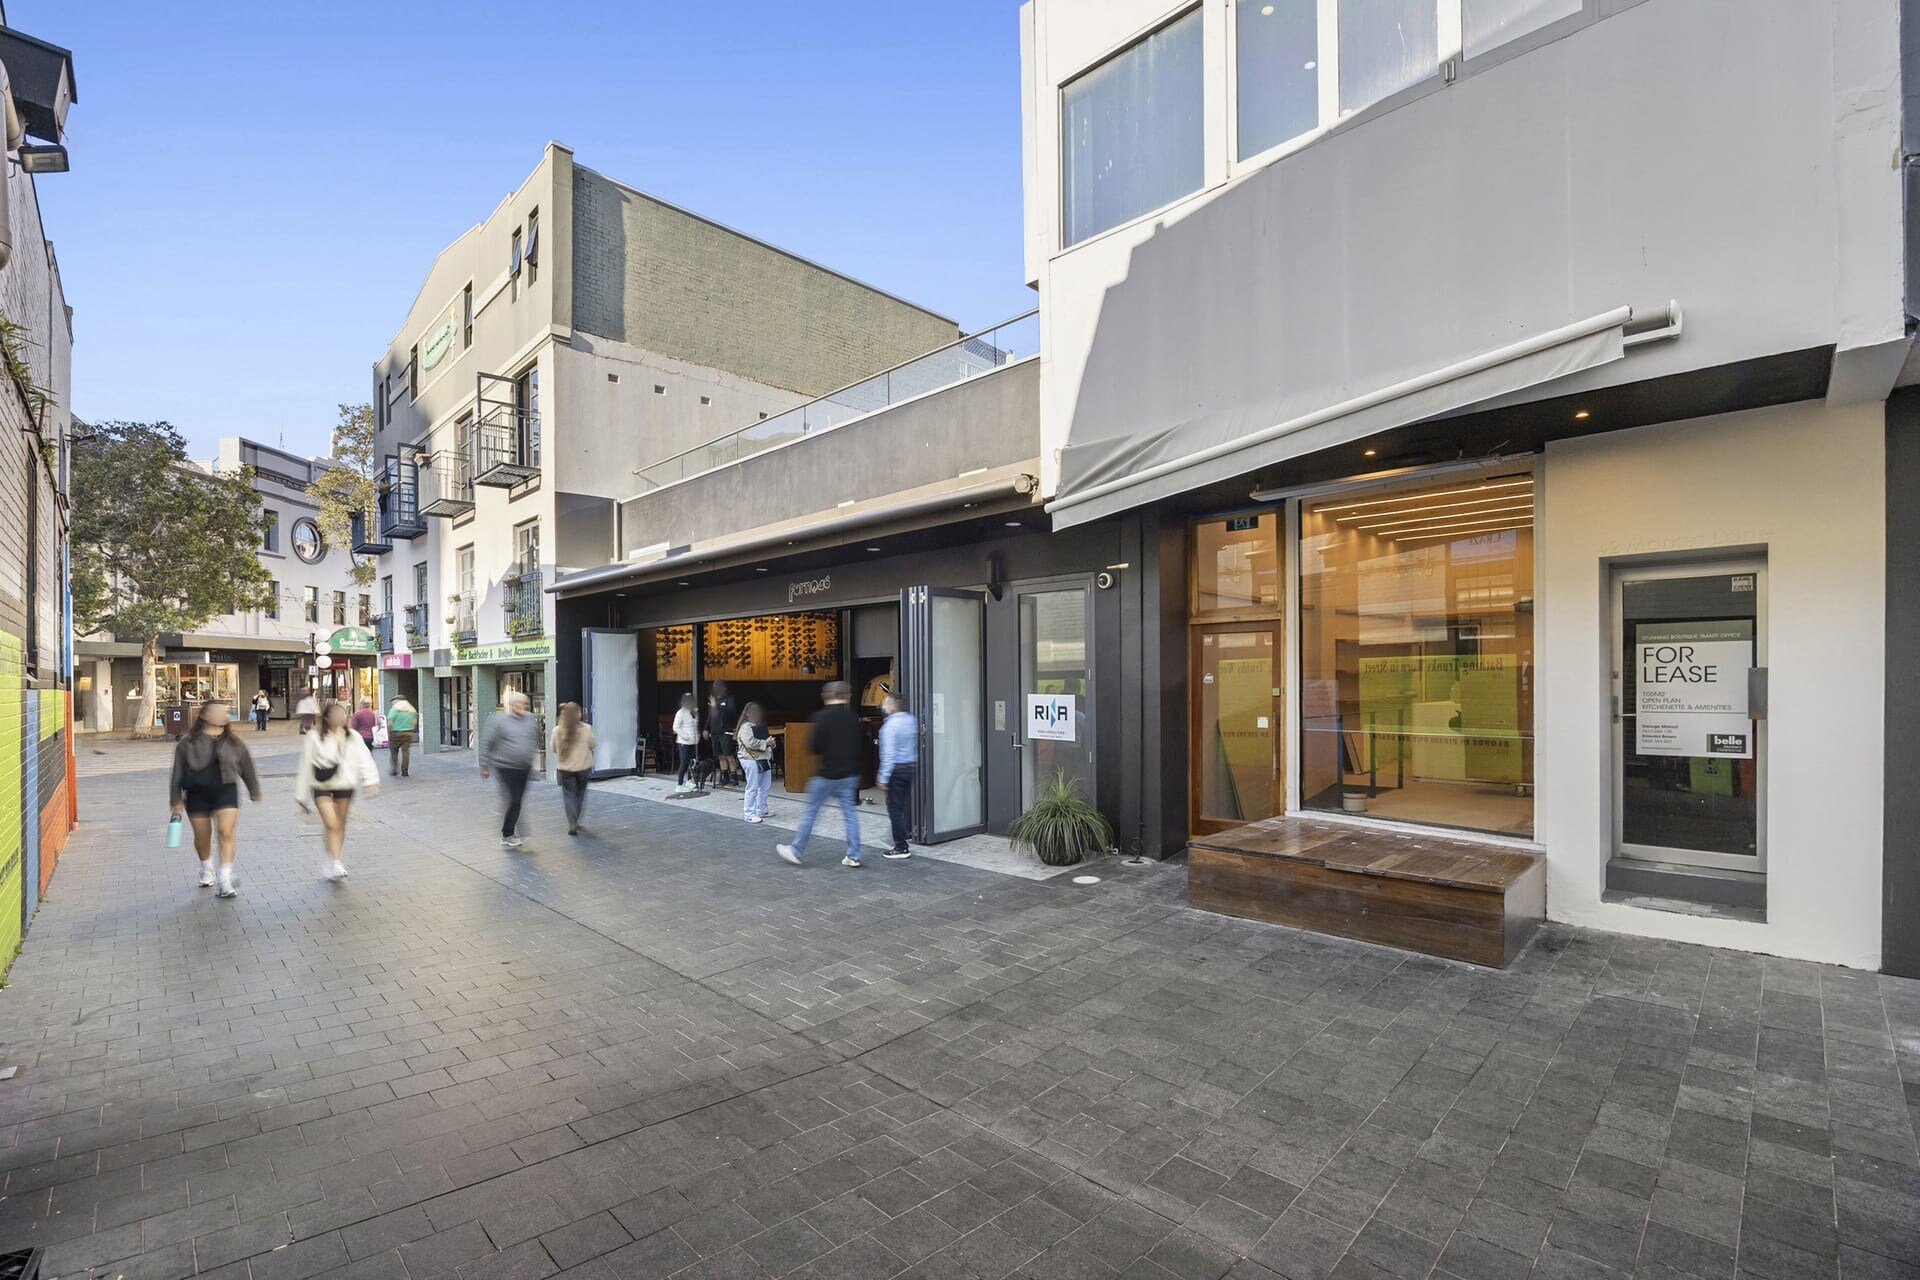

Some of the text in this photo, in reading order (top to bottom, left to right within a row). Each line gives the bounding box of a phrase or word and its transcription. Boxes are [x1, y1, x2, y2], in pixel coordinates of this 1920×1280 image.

[514, 644, 550, 656] Accommodation
[1643, 646, 1694, 663] FOR
[1643, 665, 1718, 683] LEASE
[1034, 699, 1068, 727] RINA
[1713, 735, 1743, 745] belle
